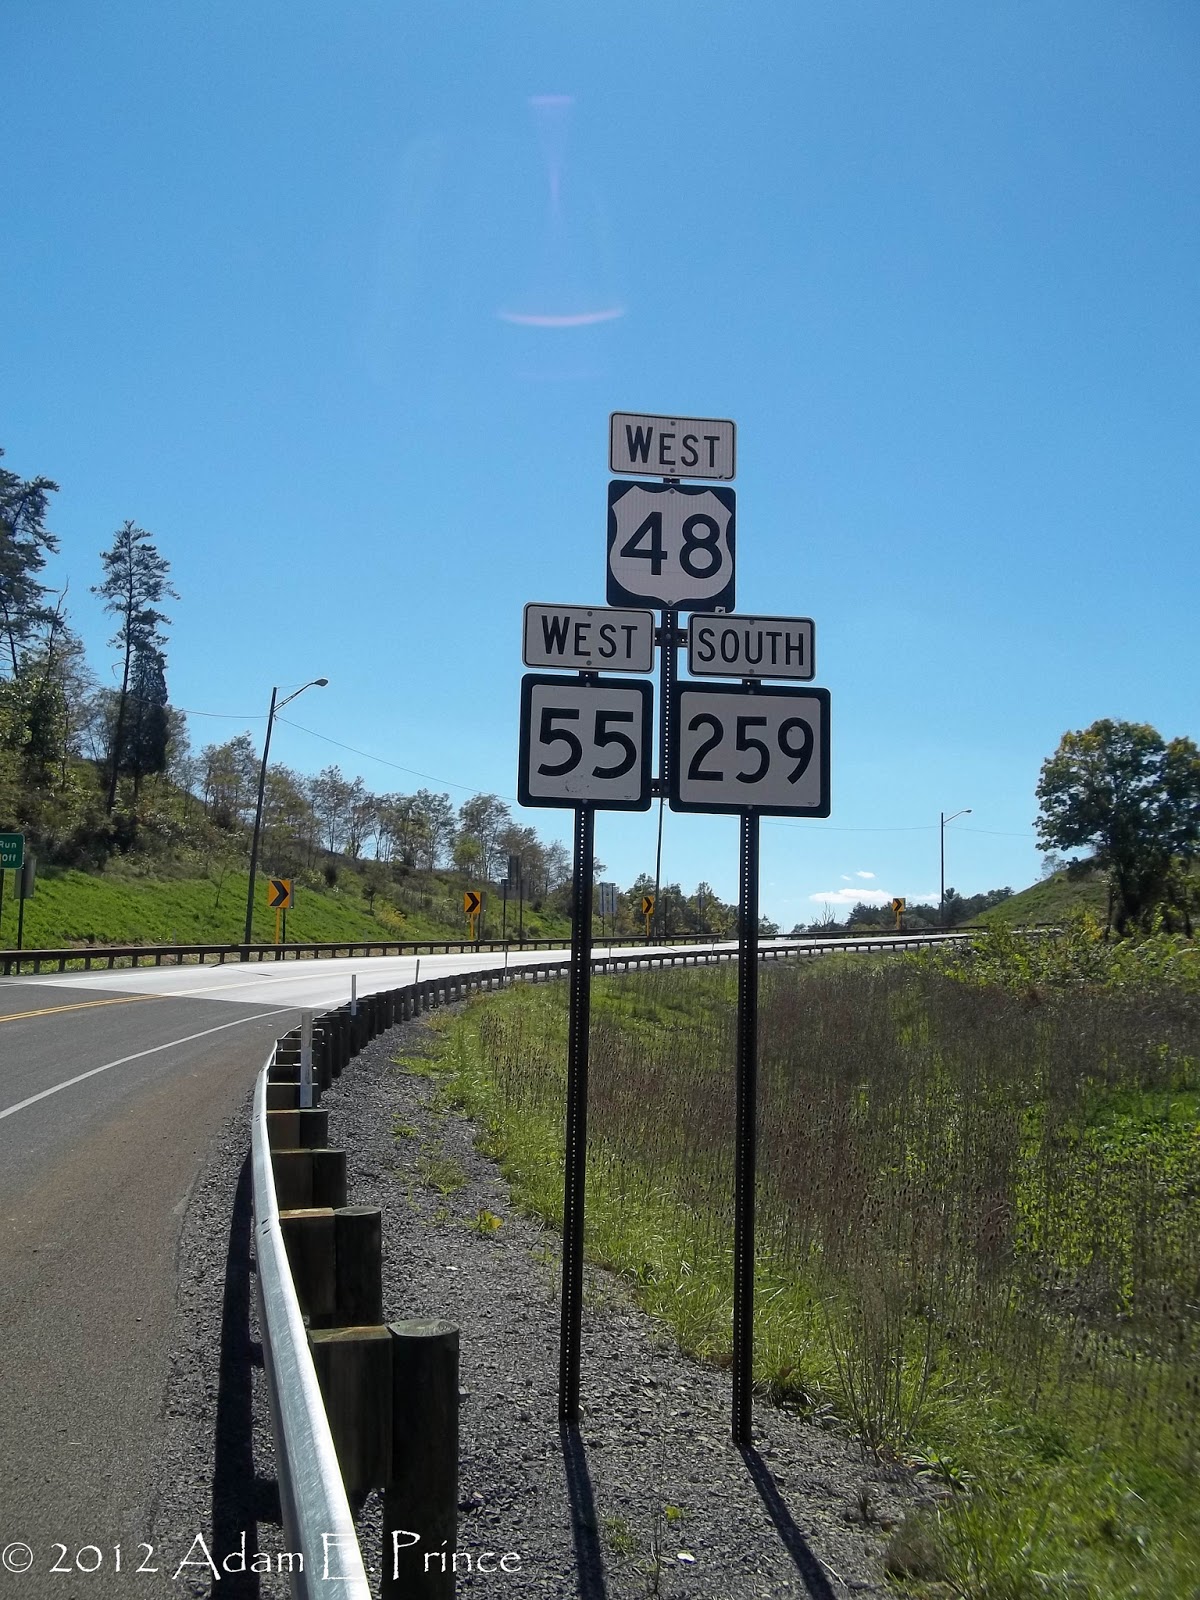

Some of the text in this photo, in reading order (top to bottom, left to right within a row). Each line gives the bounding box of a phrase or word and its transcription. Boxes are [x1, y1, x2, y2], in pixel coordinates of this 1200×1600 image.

[625, 424, 720, 468] WEST
[620, 511, 723, 579] 48
[541, 615, 638, 659] WEST
[697, 627, 804, 667] SOUTH
[537, 707, 637, 780] 55
[687, 712, 814, 785] 259
